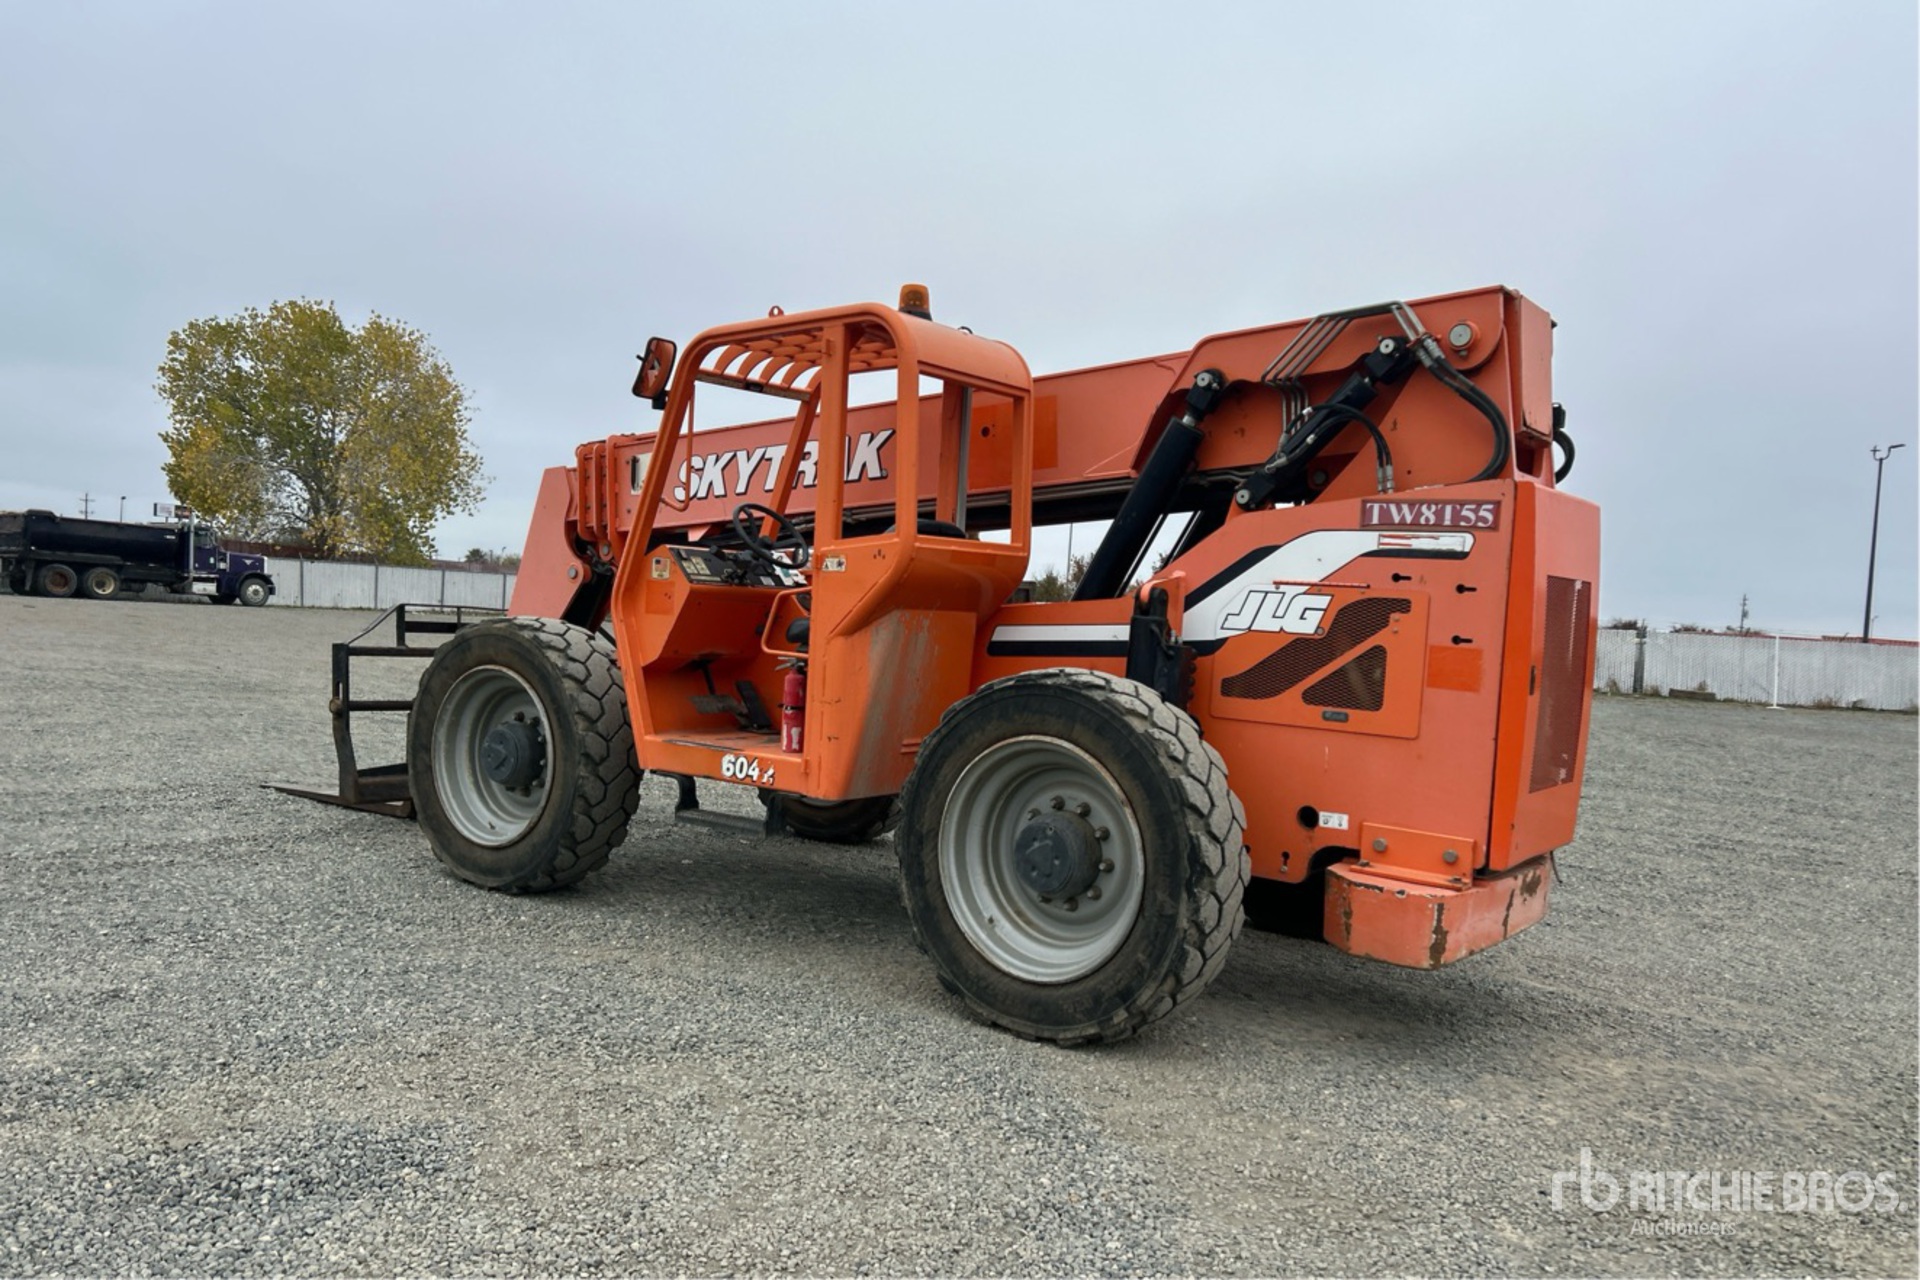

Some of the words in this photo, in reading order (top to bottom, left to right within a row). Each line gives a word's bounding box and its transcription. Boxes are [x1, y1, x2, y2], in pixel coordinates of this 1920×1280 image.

[673, 428, 896, 501] SKYTRK
[1366, 502, 1494, 528] TW8T55
[1220, 590, 1334, 635] JLG
